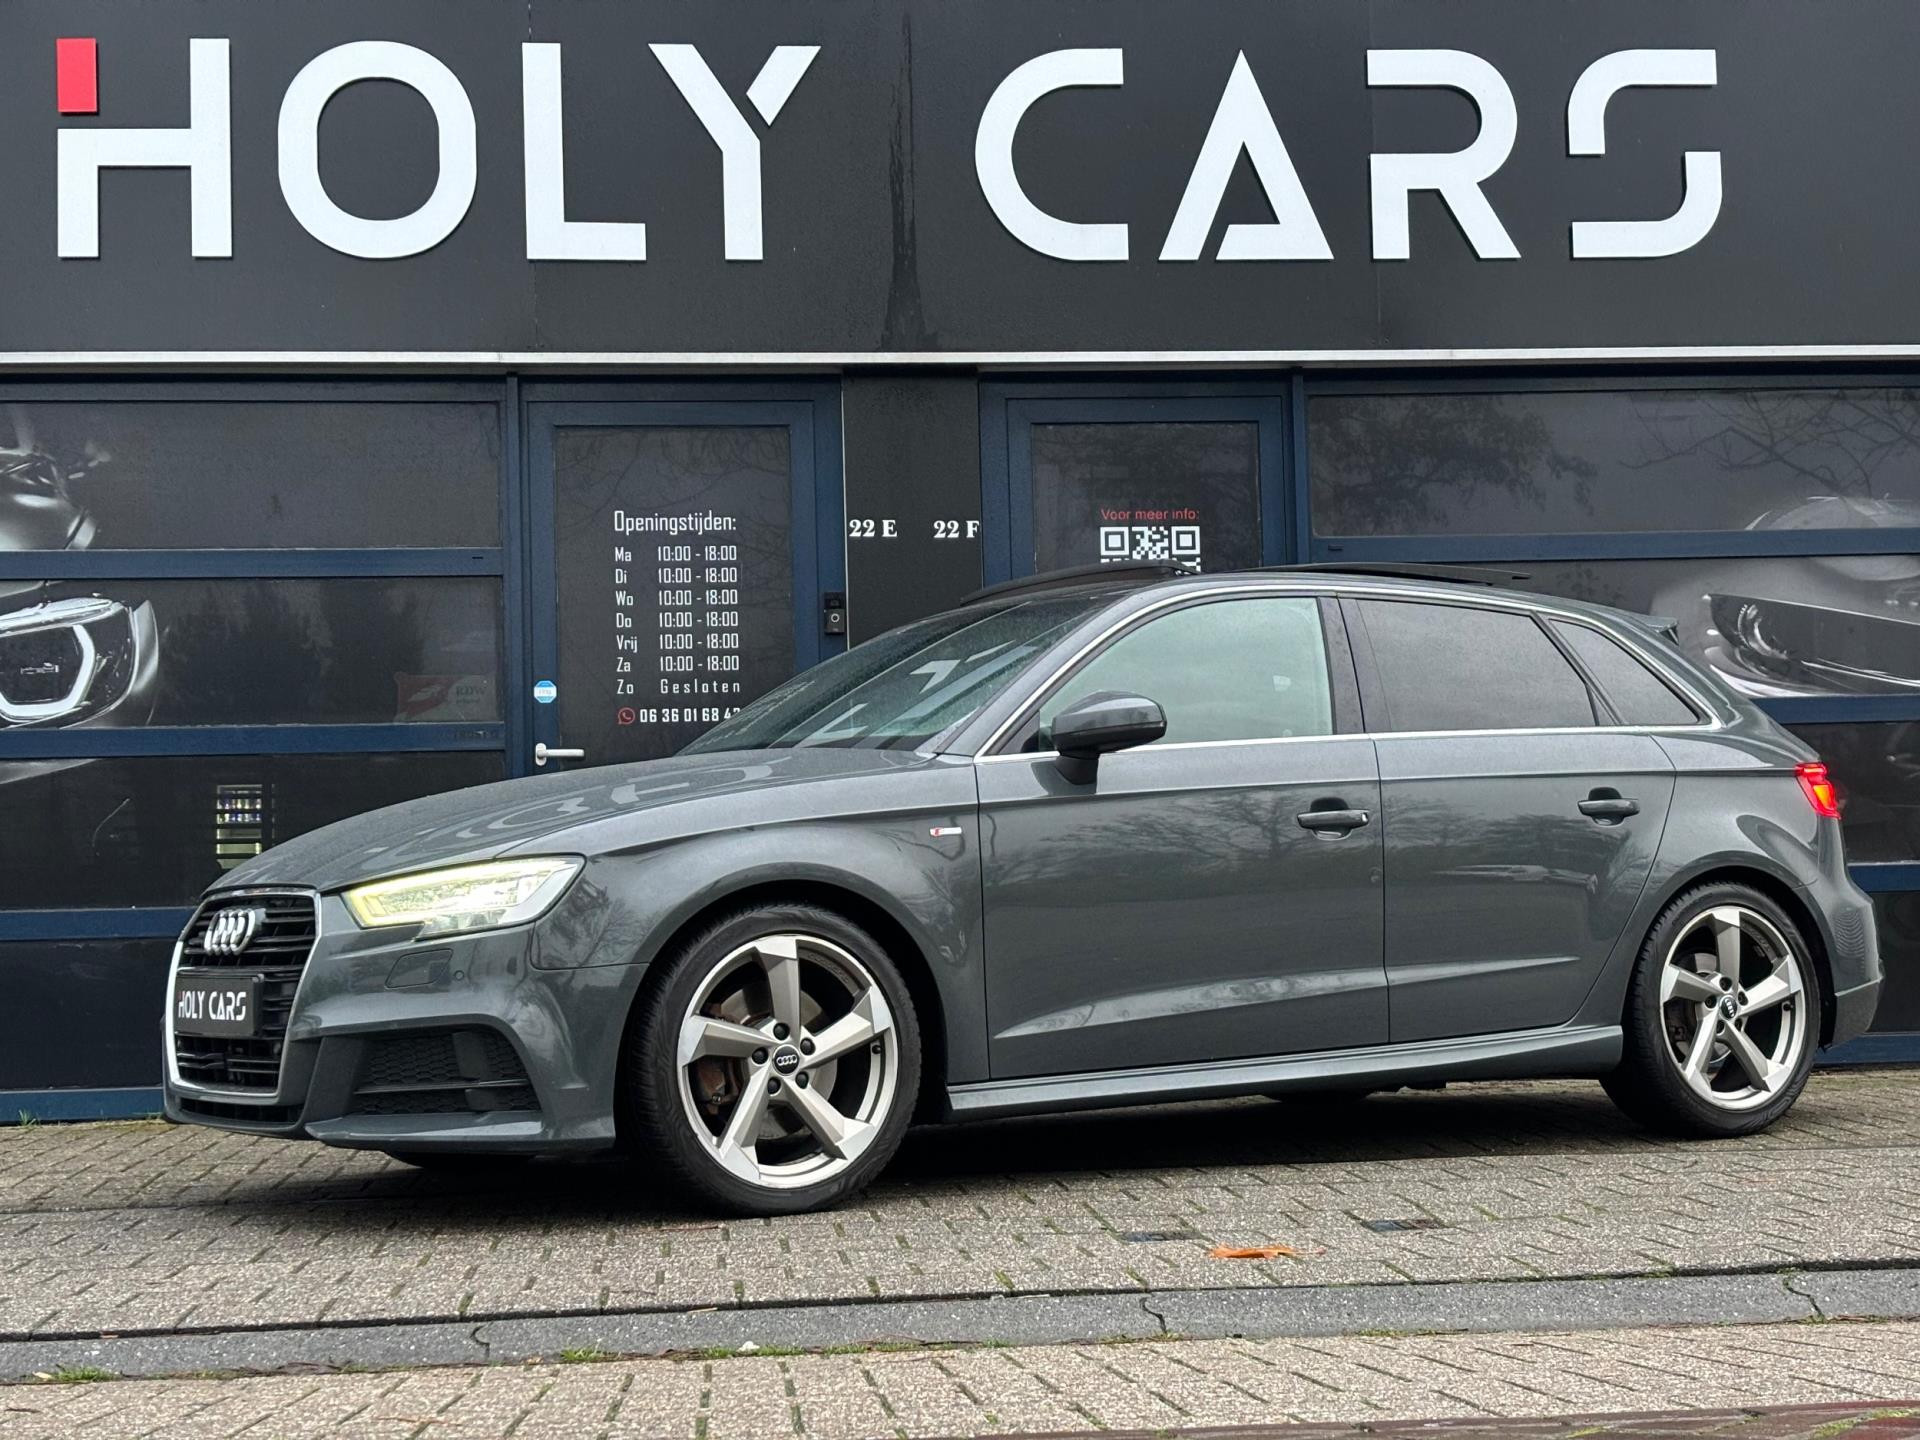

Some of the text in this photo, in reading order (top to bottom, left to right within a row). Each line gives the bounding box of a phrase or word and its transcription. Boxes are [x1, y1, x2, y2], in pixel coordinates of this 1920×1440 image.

[57, 38, 1723, 262] HOLY CARS
[1101, 508, 1200, 520] Voor meer info:
[614, 510, 737, 536] Openingstijden:
[849, 519, 898, 537] 22 E
[933, 520, 980, 538] 22 F
[615, 547, 632, 562] Ma
[658, 546, 691, 561] 10:00
[705, 545, 737, 561] 18:00
[615, 568, 627, 584] Di
[658, 568, 692, 583] 10:00
[705, 567, 737, 583] 18:00
[615, 590, 634, 606] Wo
[659, 590, 692, 606] 10:00
[706, 589, 738, 605] 18:00
[616, 612, 632, 628] Do
[659, 612, 693, 628] 10:00
[706, 611, 738, 627] 18:00
[616, 634, 638, 653] Vrij
[660, 634, 693, 649] 10:00
[707, 633, 739, 649] 18:00
[616, 656, 631, 672] Za
[660, 656, 693, 671] 10:00
[707, 655, 740, 671] 18:00
[616, 678, 740, 694] Zo Gesloten
[640, 708, 657, 723] 06
[662, 708, 679, 722] 36
[683, 707, 698, 722] 01
[702, 707, 719, 722] 68
[178, 990, 247, 1021] HOLY CARS
